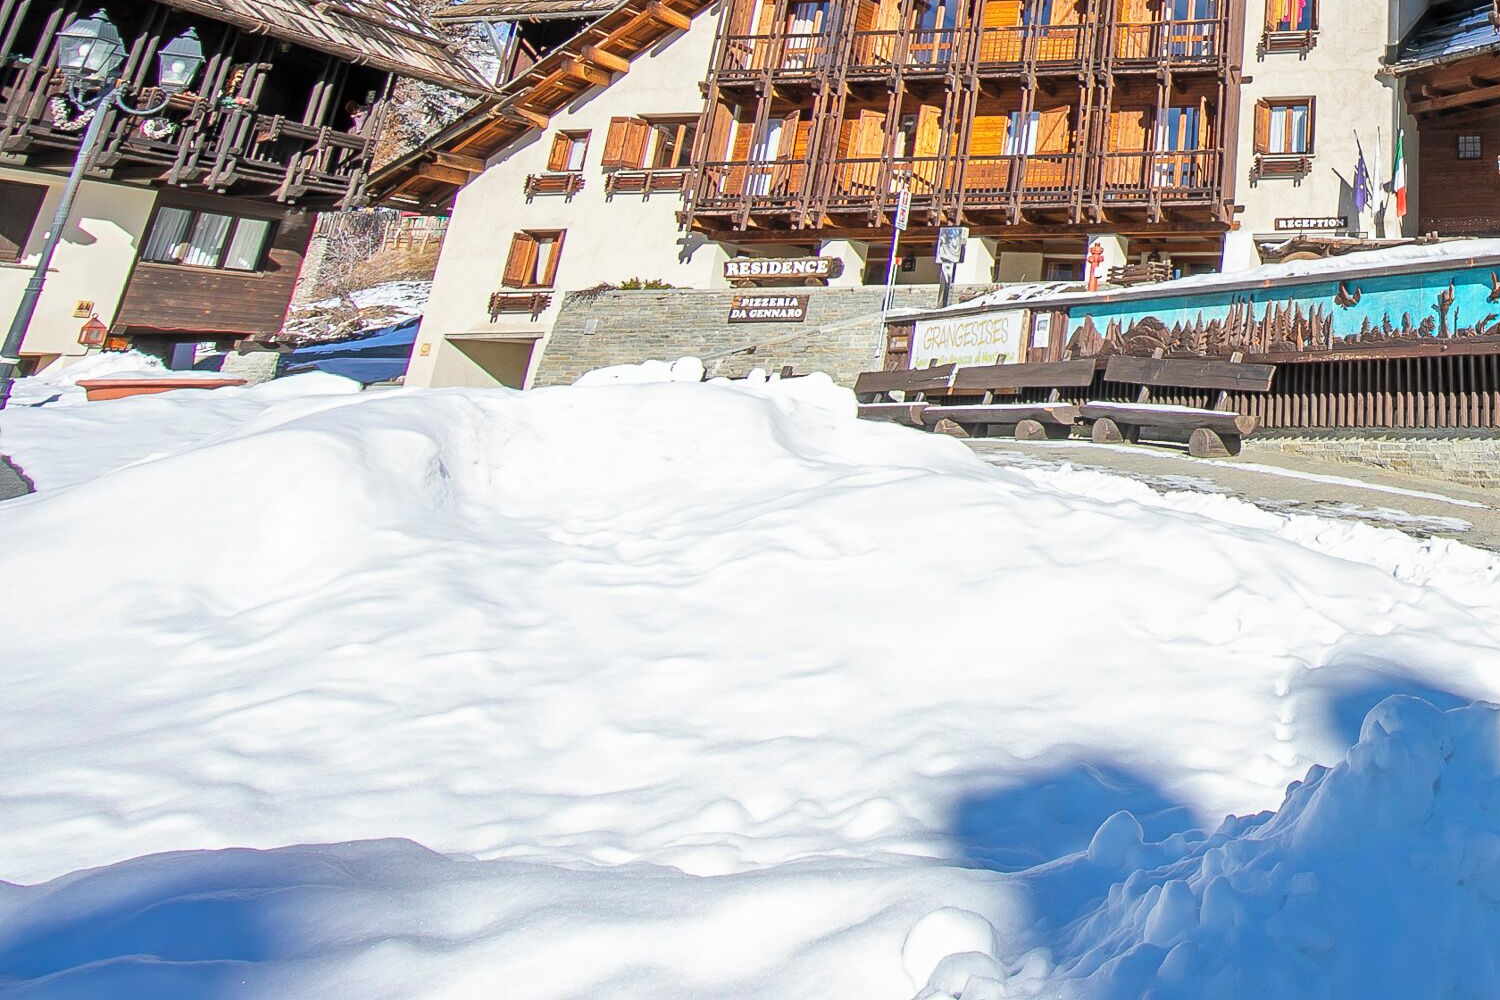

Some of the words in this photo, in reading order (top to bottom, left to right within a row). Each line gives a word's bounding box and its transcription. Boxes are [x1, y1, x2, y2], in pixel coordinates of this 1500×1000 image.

[1278, 218, 1345, 228] RECEPTION
[726, 260, 828, 276] RESIDENCE
[740, 297, 799, 307] PIZZERIA
[730, 309, 747, 318] DA
[748, 308, 803, 318] GENNARO
[923, 317, 1009, 350] GRANGESISES
